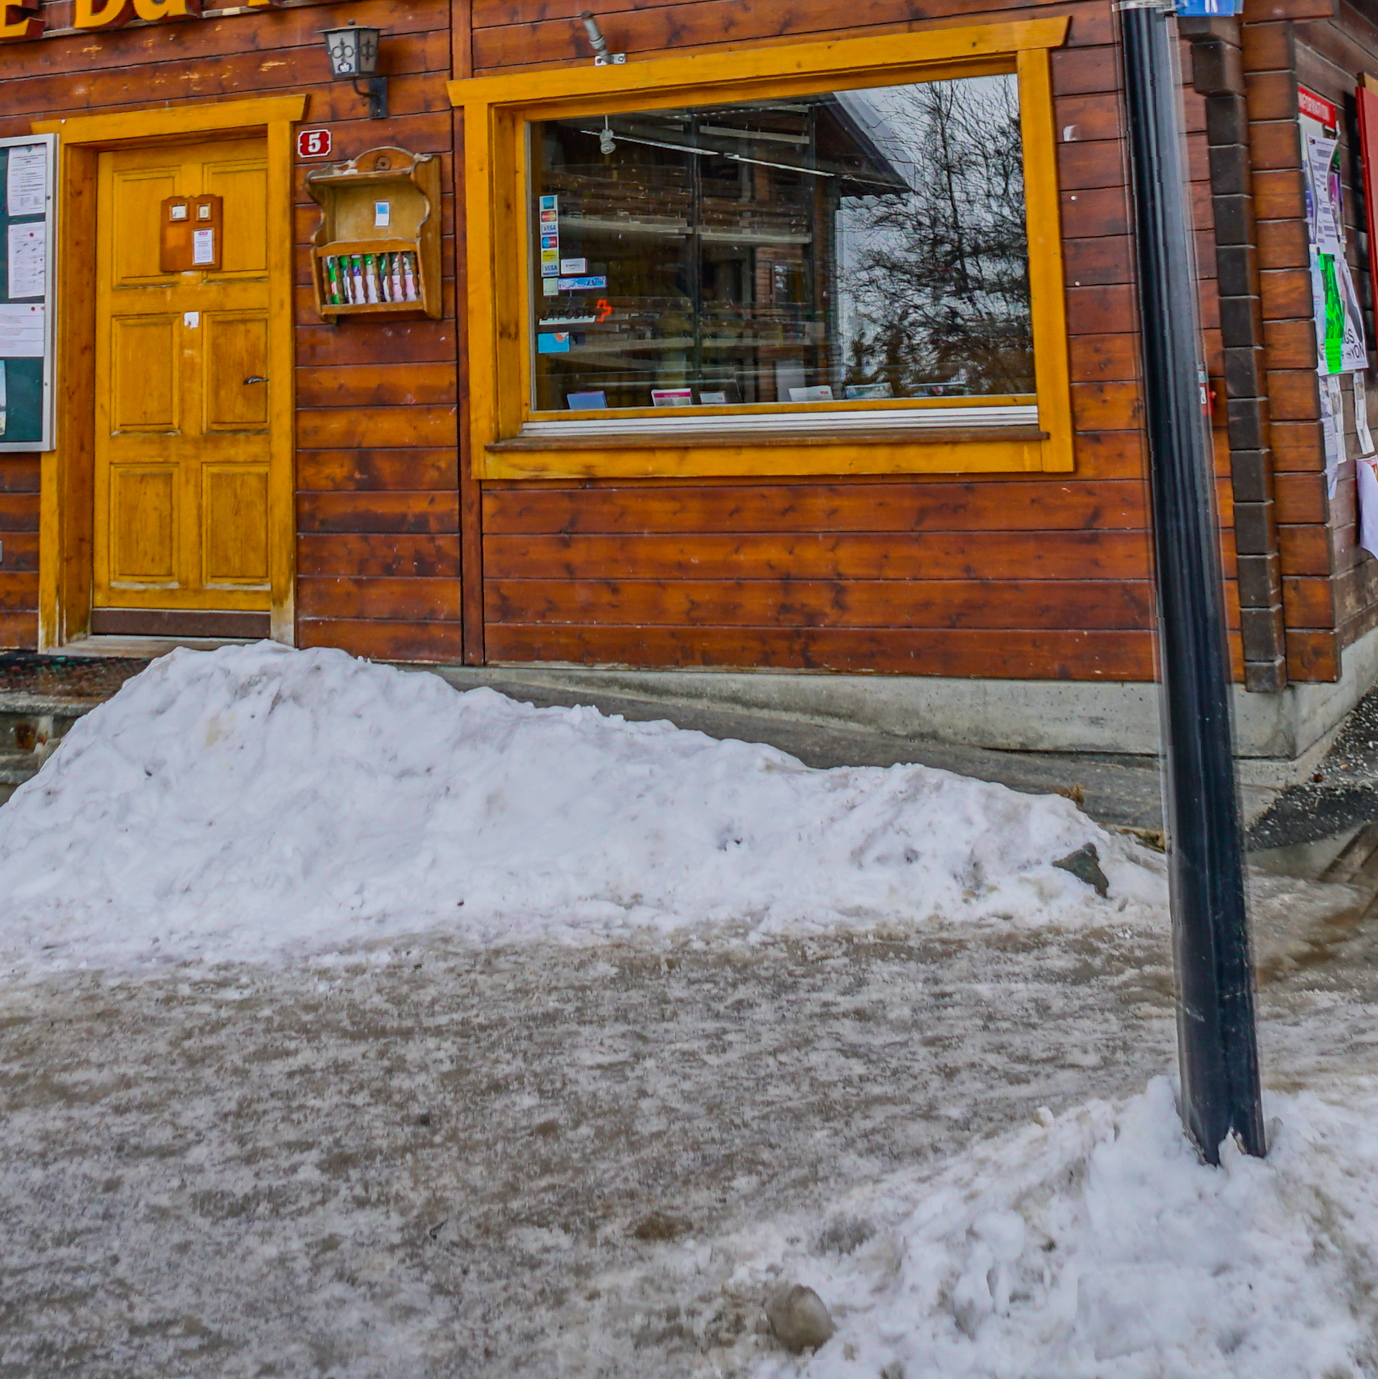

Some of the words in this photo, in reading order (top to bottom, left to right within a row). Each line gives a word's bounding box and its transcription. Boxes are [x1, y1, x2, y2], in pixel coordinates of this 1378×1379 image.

[307, 134, 321, 154] 5
[543, 224, 557, 232] VISA
[544, 264, 558, 272] VISA
